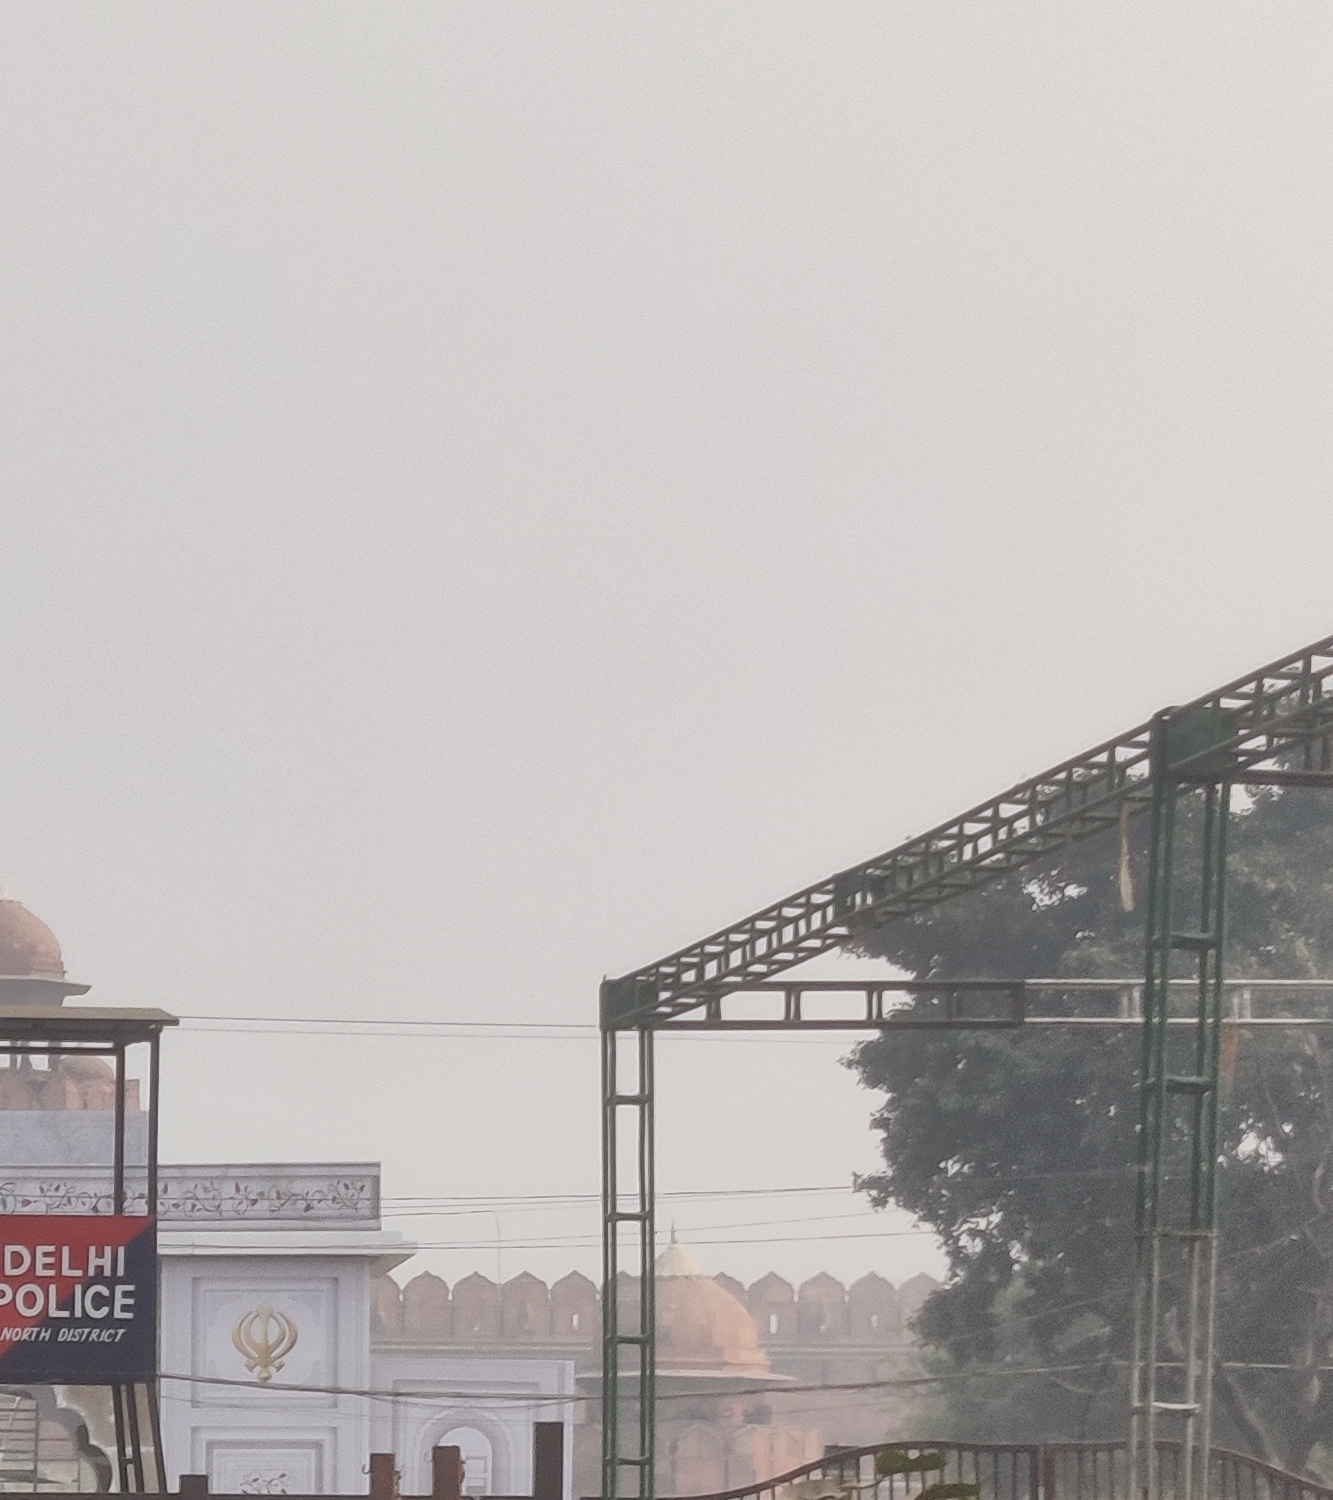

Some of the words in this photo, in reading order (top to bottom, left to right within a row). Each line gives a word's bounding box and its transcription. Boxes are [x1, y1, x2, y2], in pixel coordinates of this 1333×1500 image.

[3, 1245, 125, 1277] DELHI
[0, 1327, 52, 1342] NORTH
[57, 1327, 127, 1343] DISTRICT
